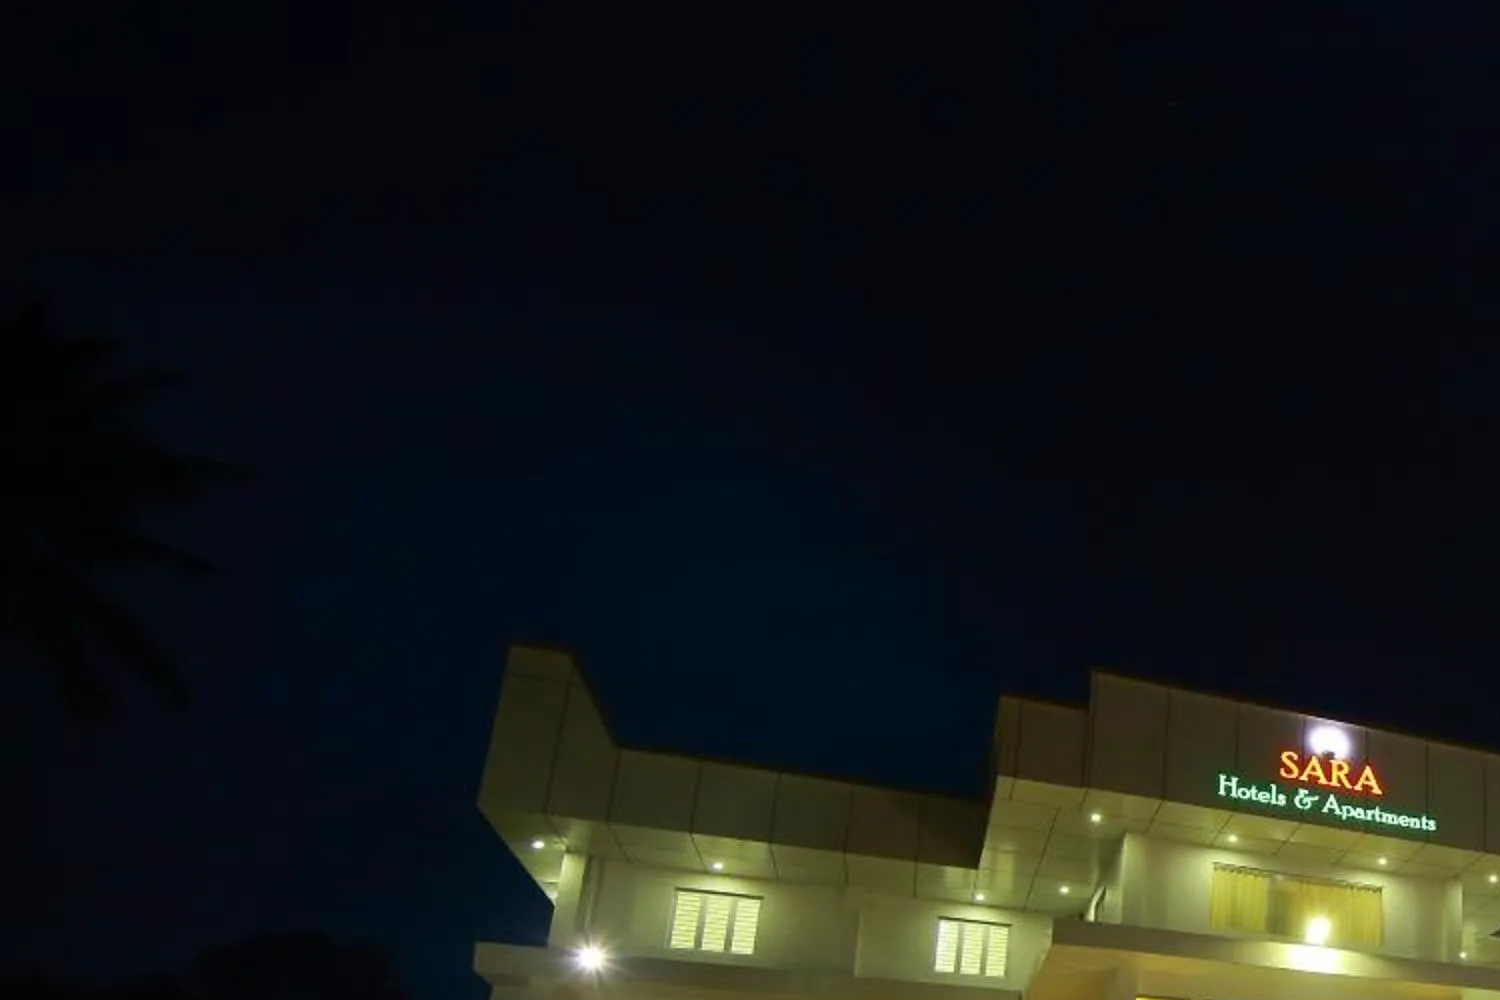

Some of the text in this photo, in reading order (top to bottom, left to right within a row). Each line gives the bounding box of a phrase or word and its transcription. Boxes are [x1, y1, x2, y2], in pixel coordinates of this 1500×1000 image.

[1280, 751, 1383, 796] SARA
[1218, 773, 1438, 831] Hotels & Apartments
